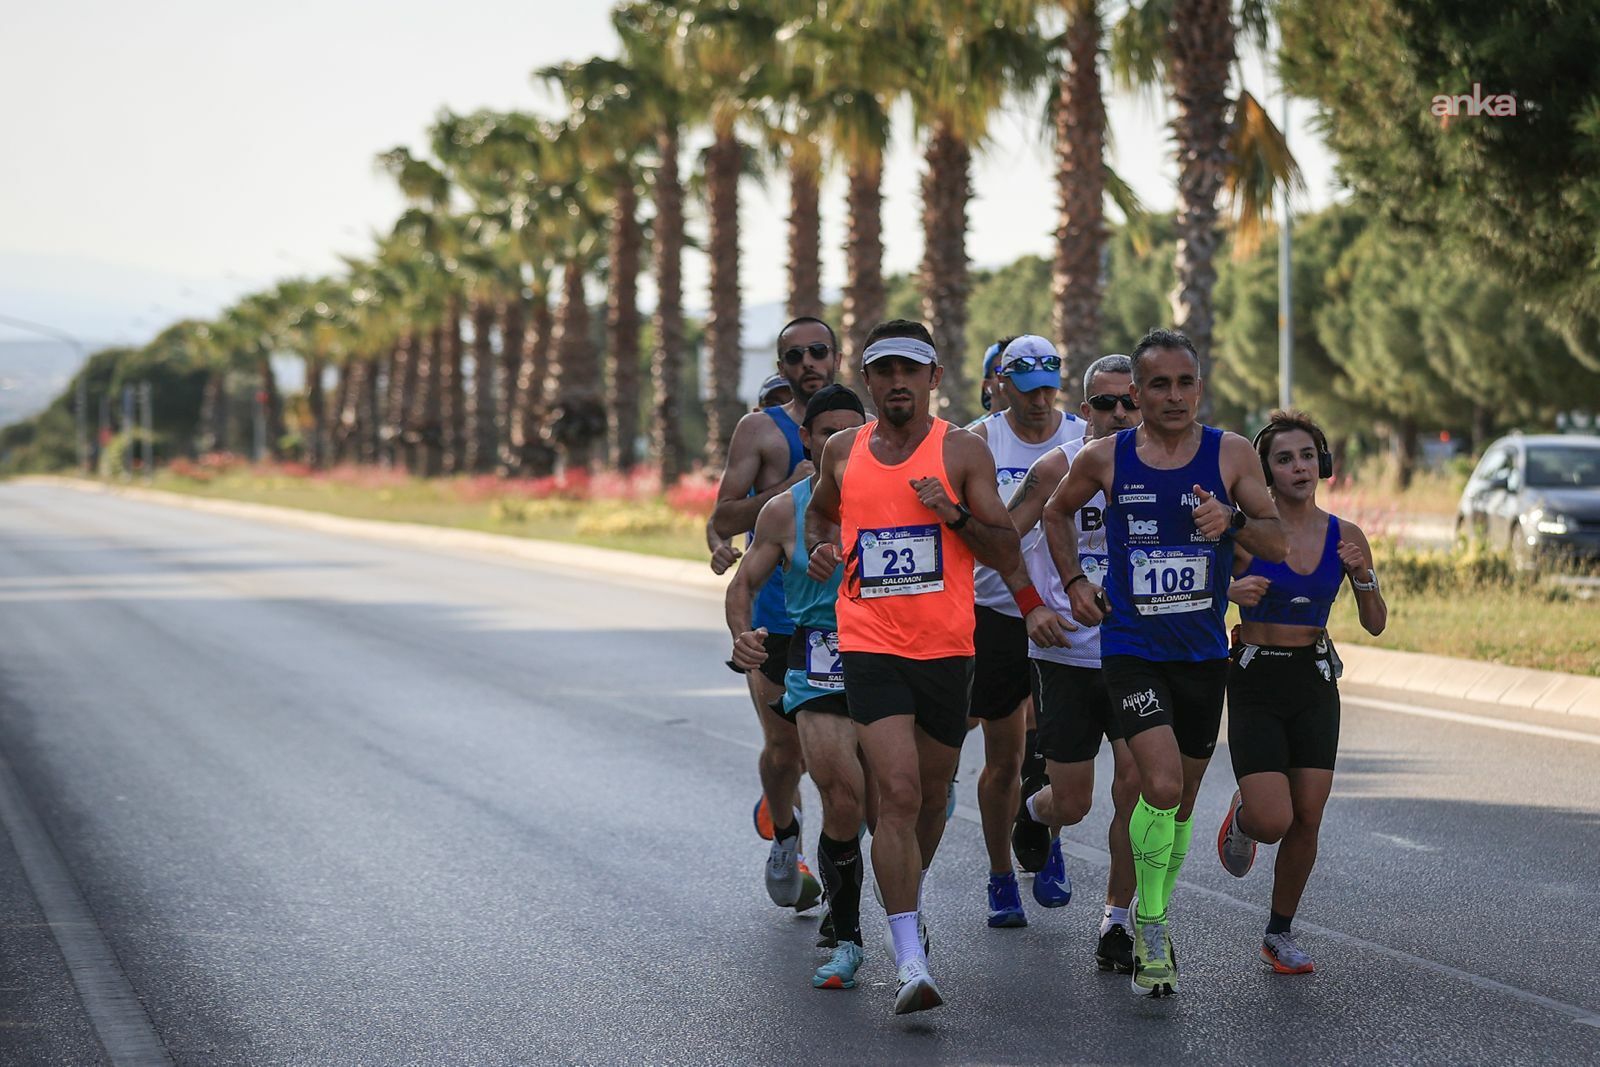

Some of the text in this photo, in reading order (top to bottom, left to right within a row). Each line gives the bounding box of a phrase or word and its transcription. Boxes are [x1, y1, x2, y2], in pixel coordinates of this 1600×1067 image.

[1127, 514, 1158, 535] ios
[882, 547, 916, 575] 23
[882, 576, 922, 585] SALOMON
[1144, 567, 1195, 594] 108
[1150, 594, 1192, 604] SALOMON
